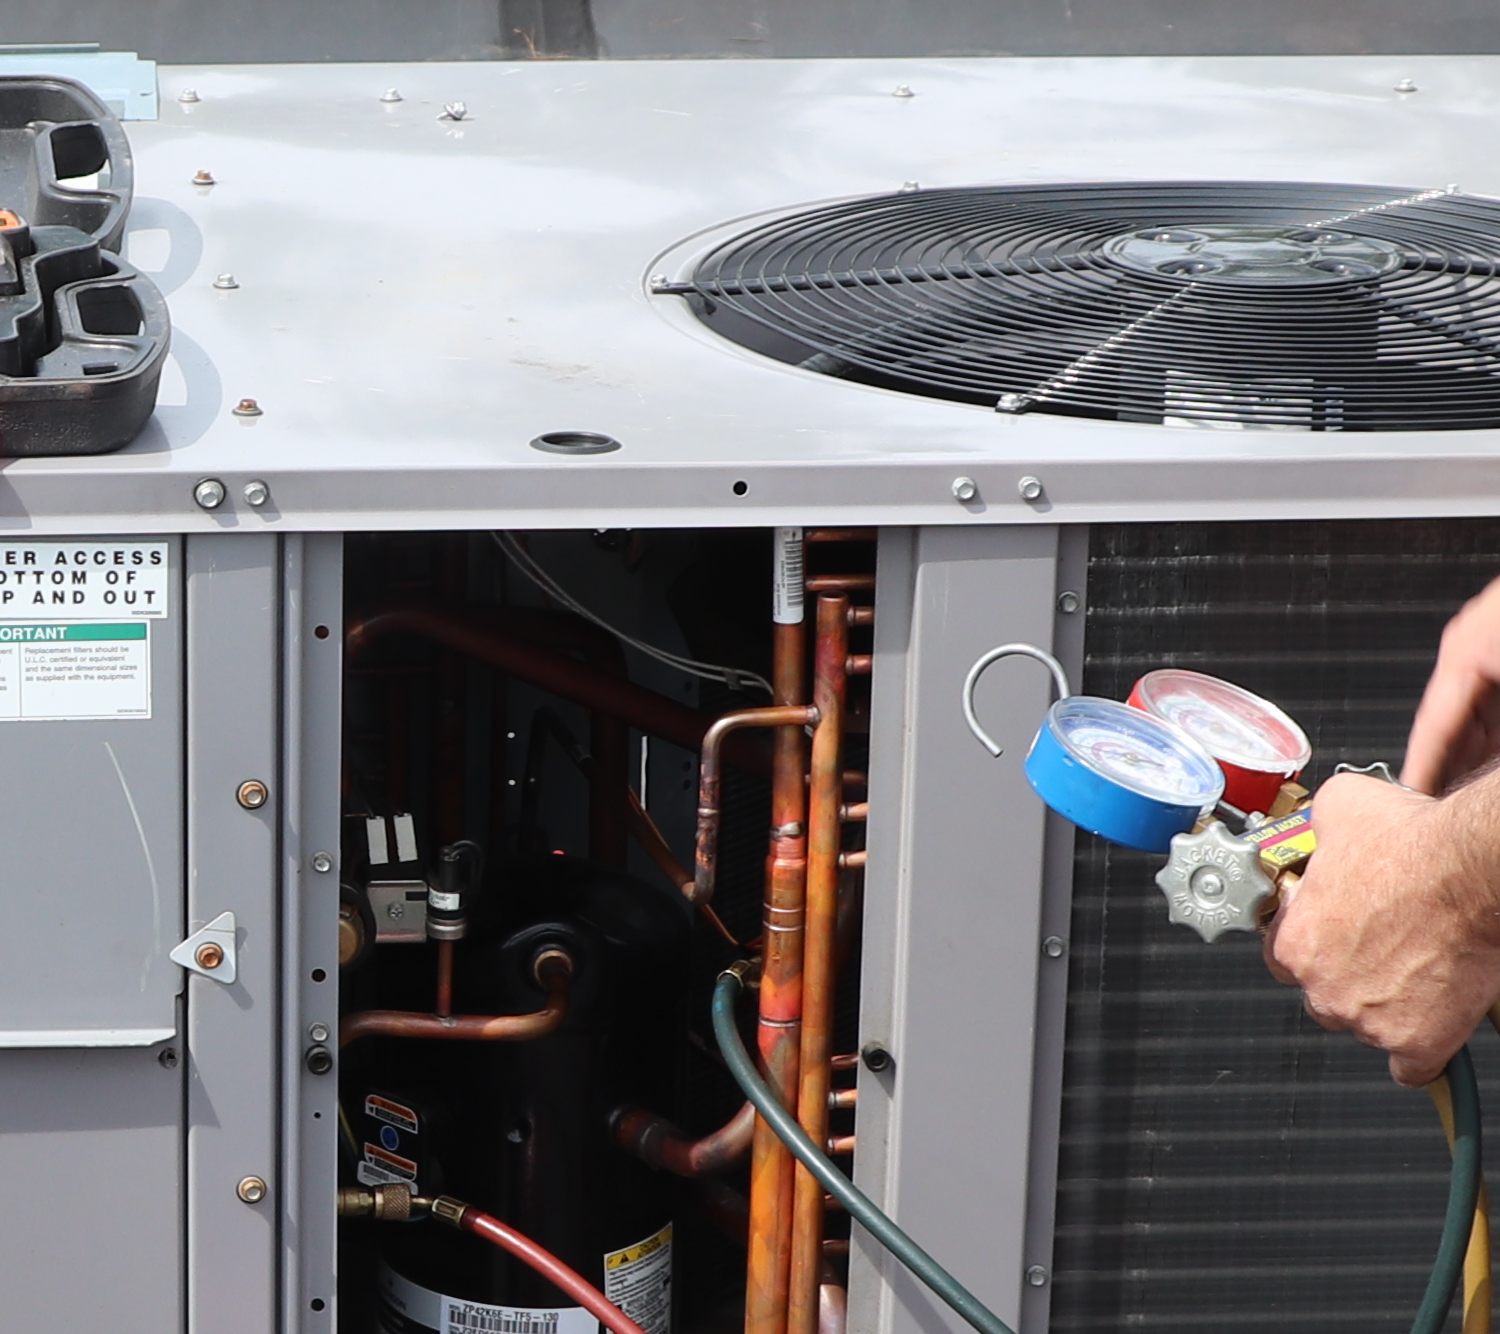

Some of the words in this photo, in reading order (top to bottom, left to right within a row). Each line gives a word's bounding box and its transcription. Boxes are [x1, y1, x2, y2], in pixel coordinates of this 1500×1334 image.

[54, 551, 163, 565] ACCESS
[105, 571, 138, 585] OF
[32, 591, 87, 605] AND
[103, 591, 158, 604] OUT
[1173, 892, 1241, 927] YELLOW
